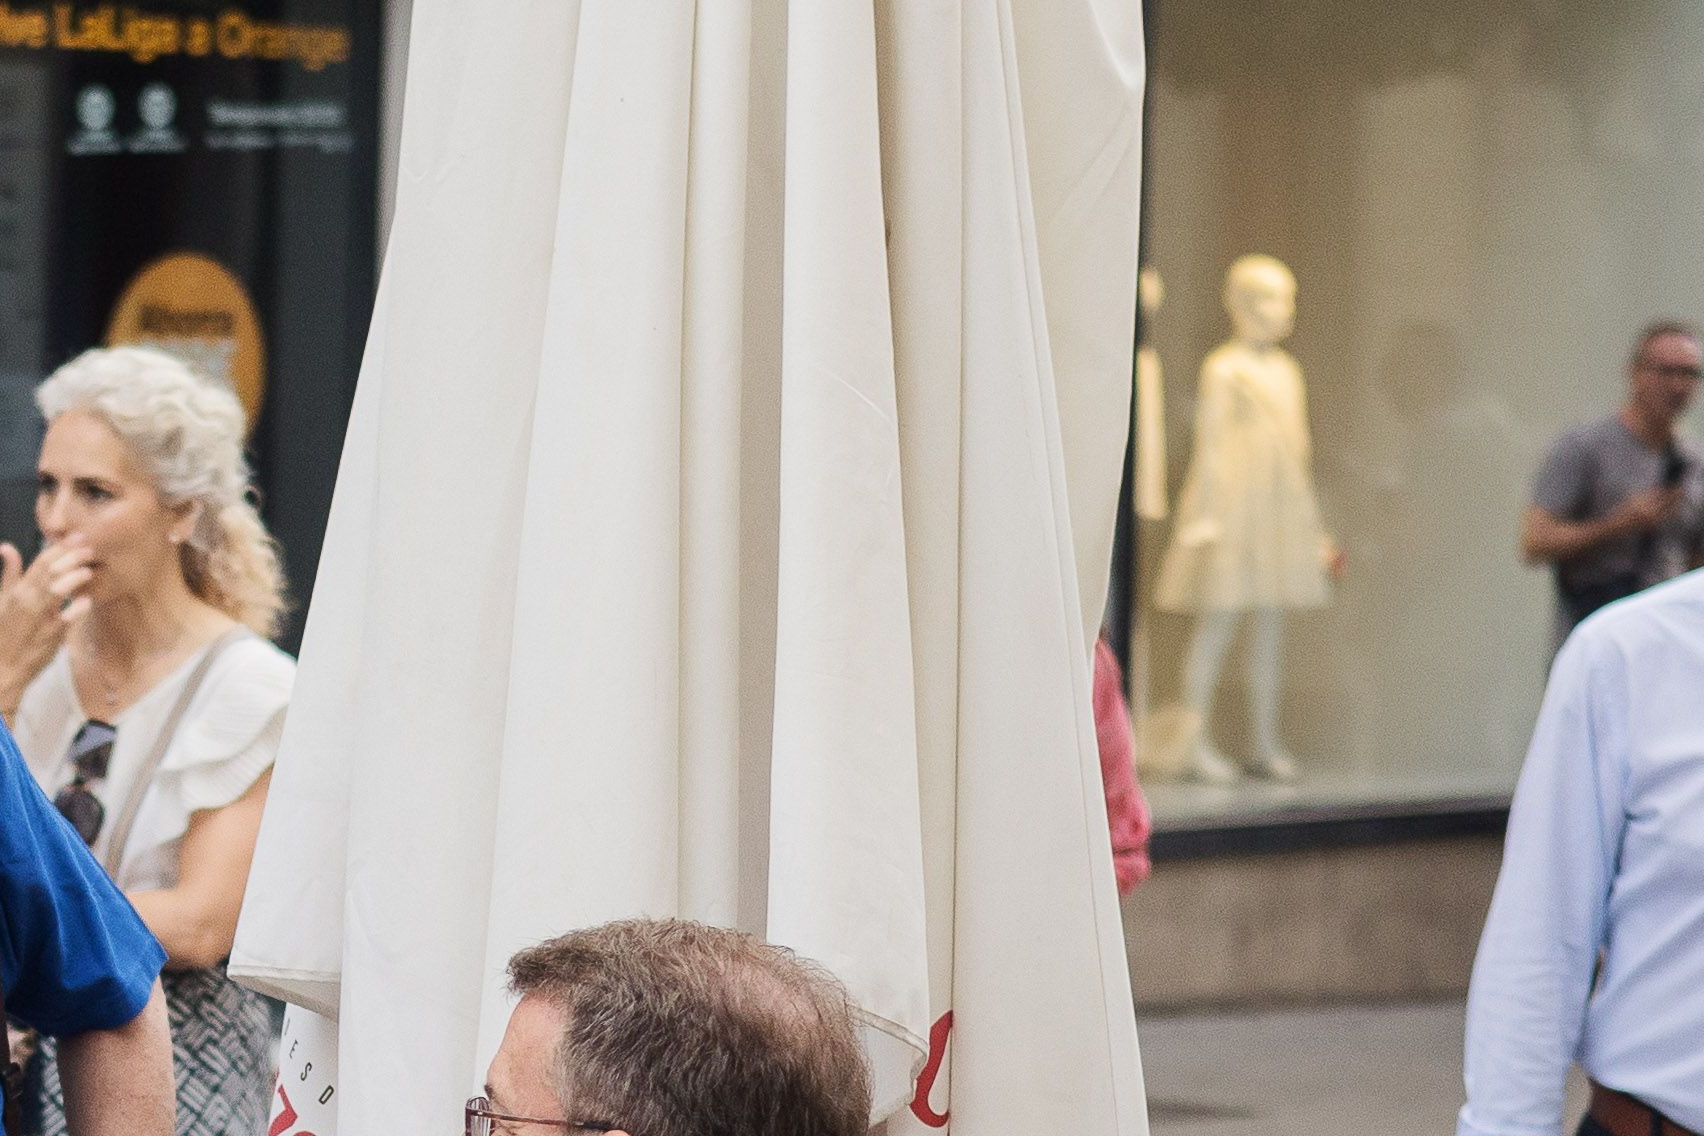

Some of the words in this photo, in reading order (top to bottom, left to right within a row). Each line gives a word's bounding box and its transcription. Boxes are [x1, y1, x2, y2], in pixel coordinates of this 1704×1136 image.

[53, 3, 182, 63] LaLiga
[215, 9, 353, 71] Orange
[283, 1016, 336, 1106] ESD
